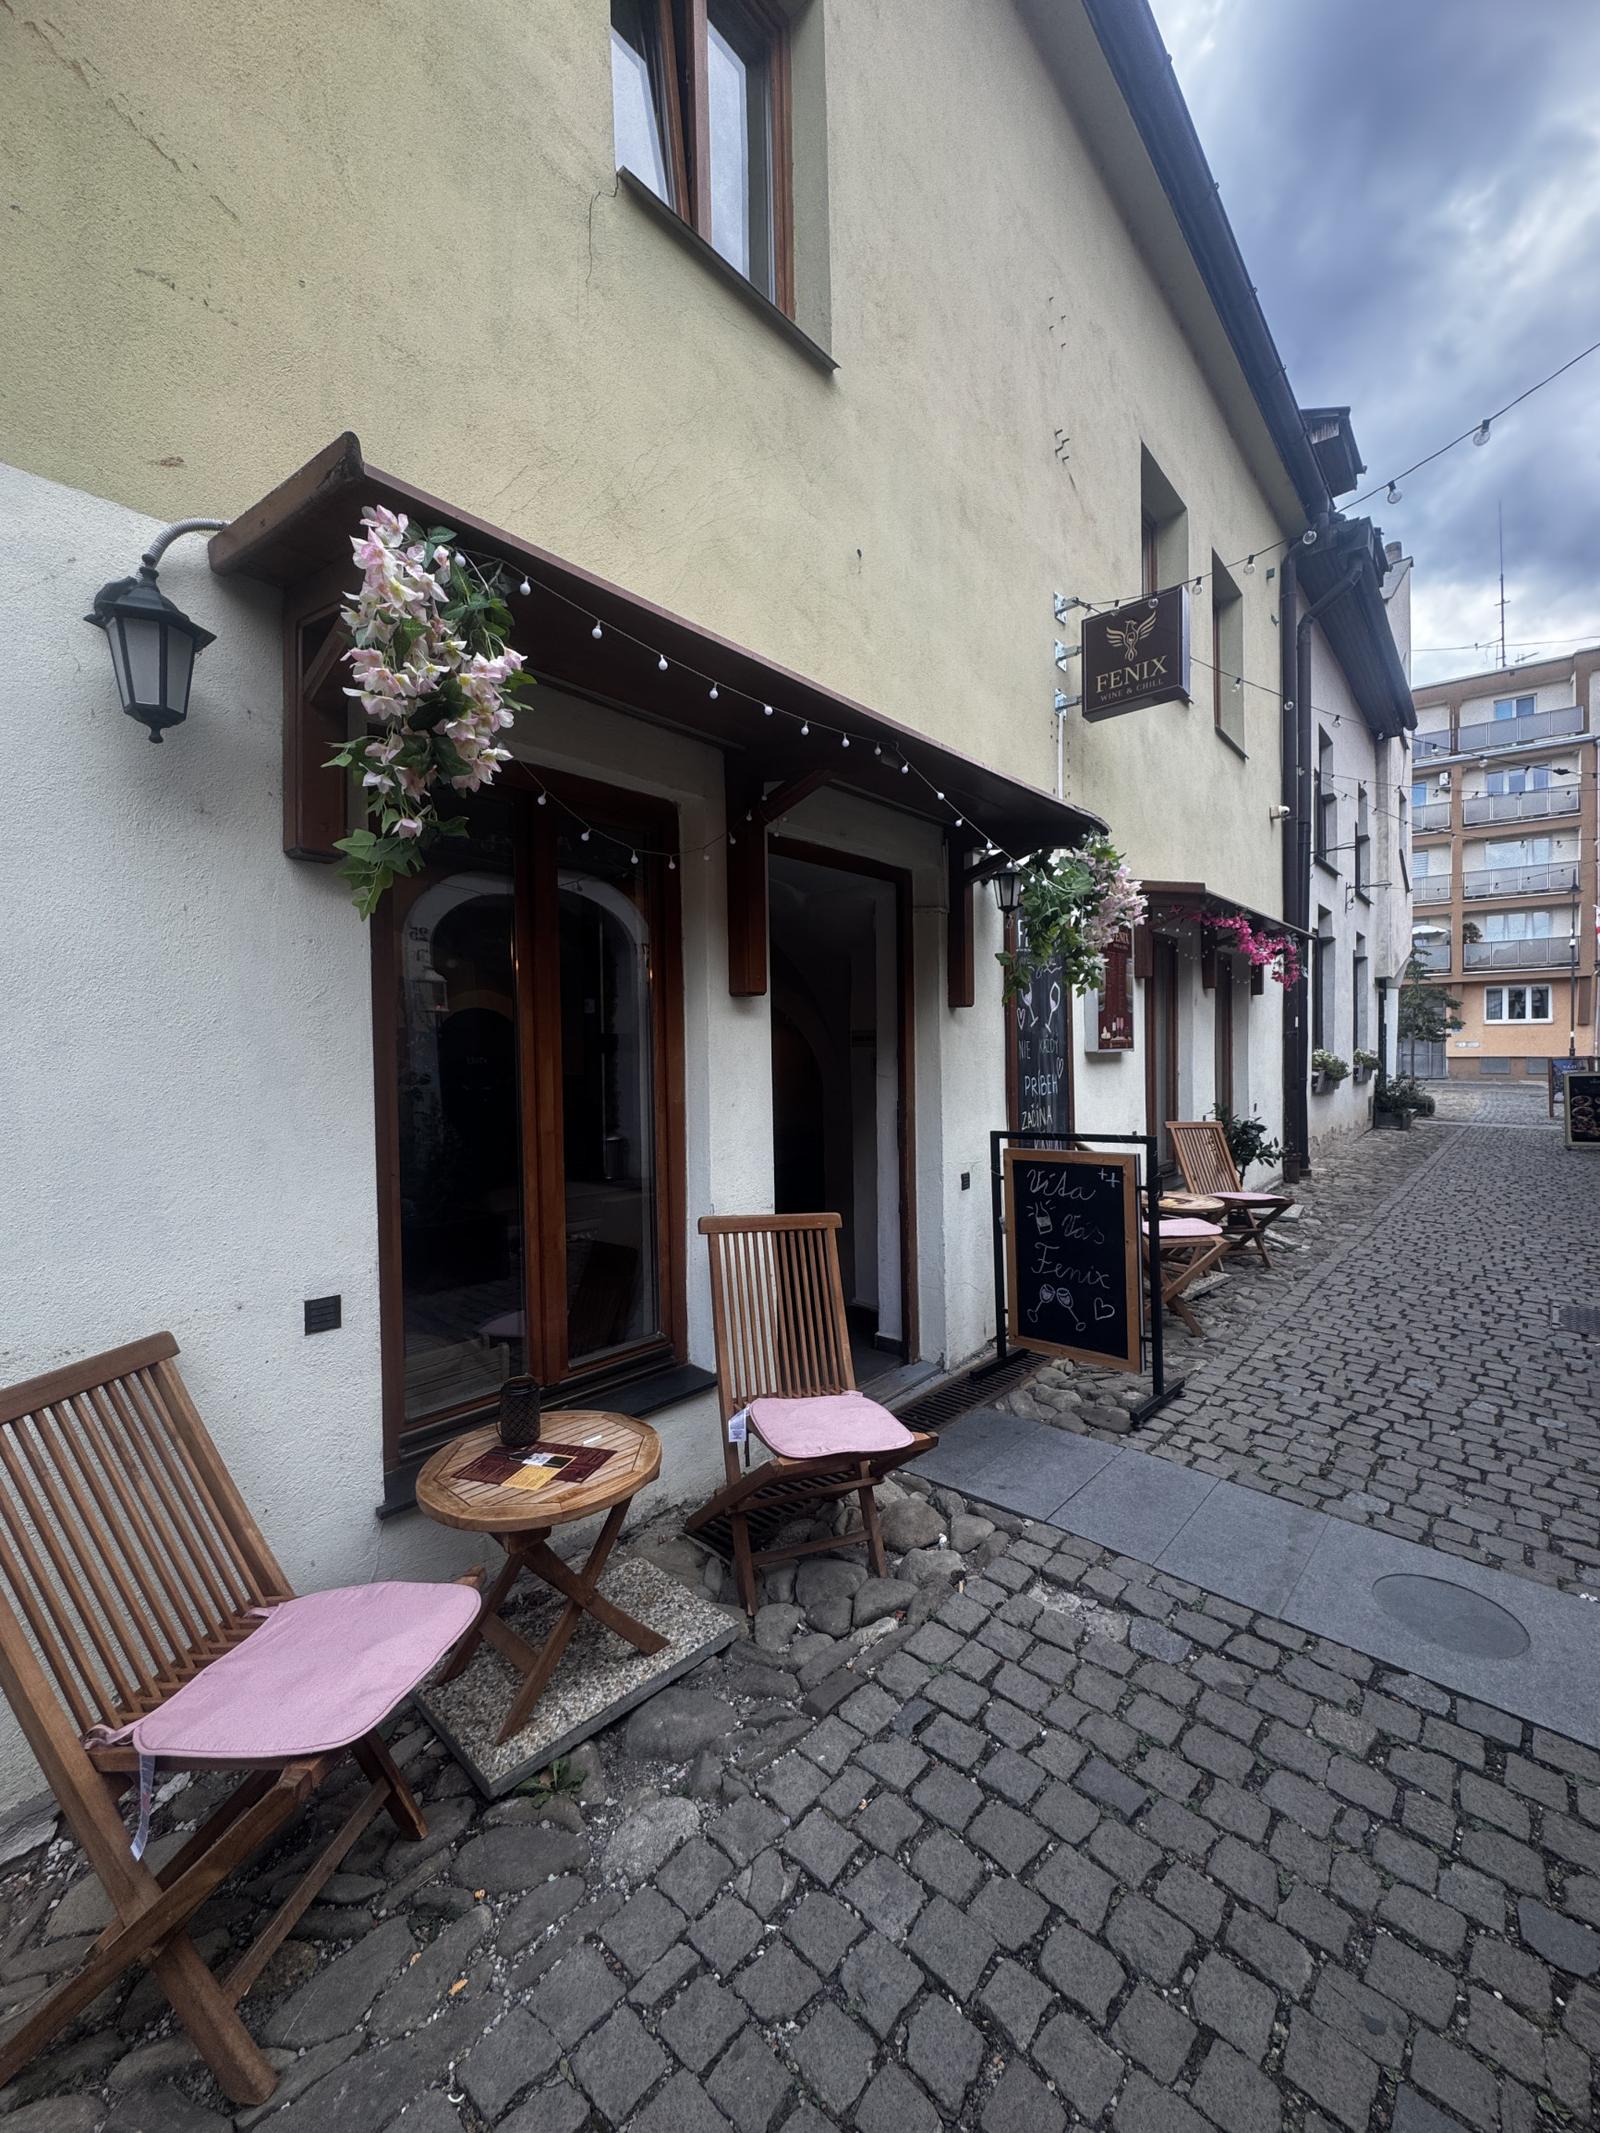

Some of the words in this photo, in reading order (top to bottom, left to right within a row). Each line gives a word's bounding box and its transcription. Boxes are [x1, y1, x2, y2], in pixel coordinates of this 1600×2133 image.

[1096, 655, 1169, 693] FENIX
[1100, 688, 1123, 703] WINE
[1126, 687, 1133, 695] &
[1136, 678, 1164, 691] CHILL
[1018, 1039, 1031, 1060] NIE
[1024, 1069, 1059, 1096] PRÍBEH
[1030, 1242, 1112, 1290] Fenix
